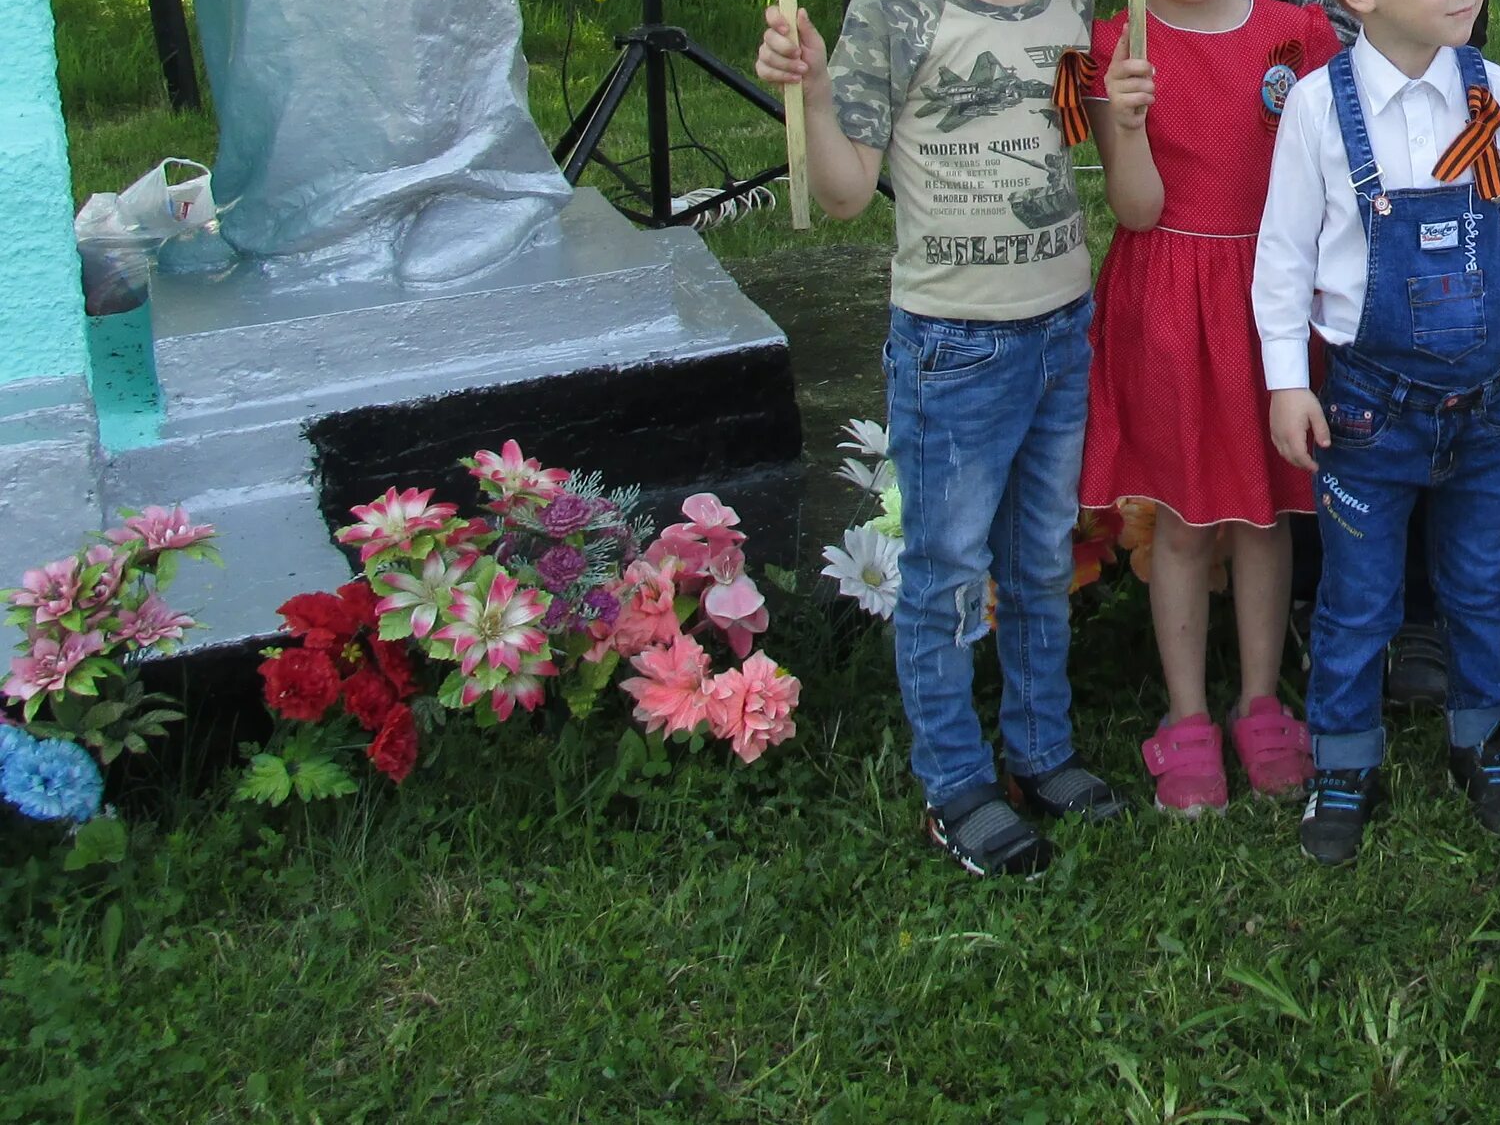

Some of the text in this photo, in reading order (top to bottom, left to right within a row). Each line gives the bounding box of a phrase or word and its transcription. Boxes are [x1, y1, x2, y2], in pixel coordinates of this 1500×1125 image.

[920, 142, 979, 156] MODERN
[925, 177, 1031, 189] RESEMBLE THOSE
[933, 194, 1004, 203] ARMORED FASTER
[1322, 472, 1370, 513] Rama
